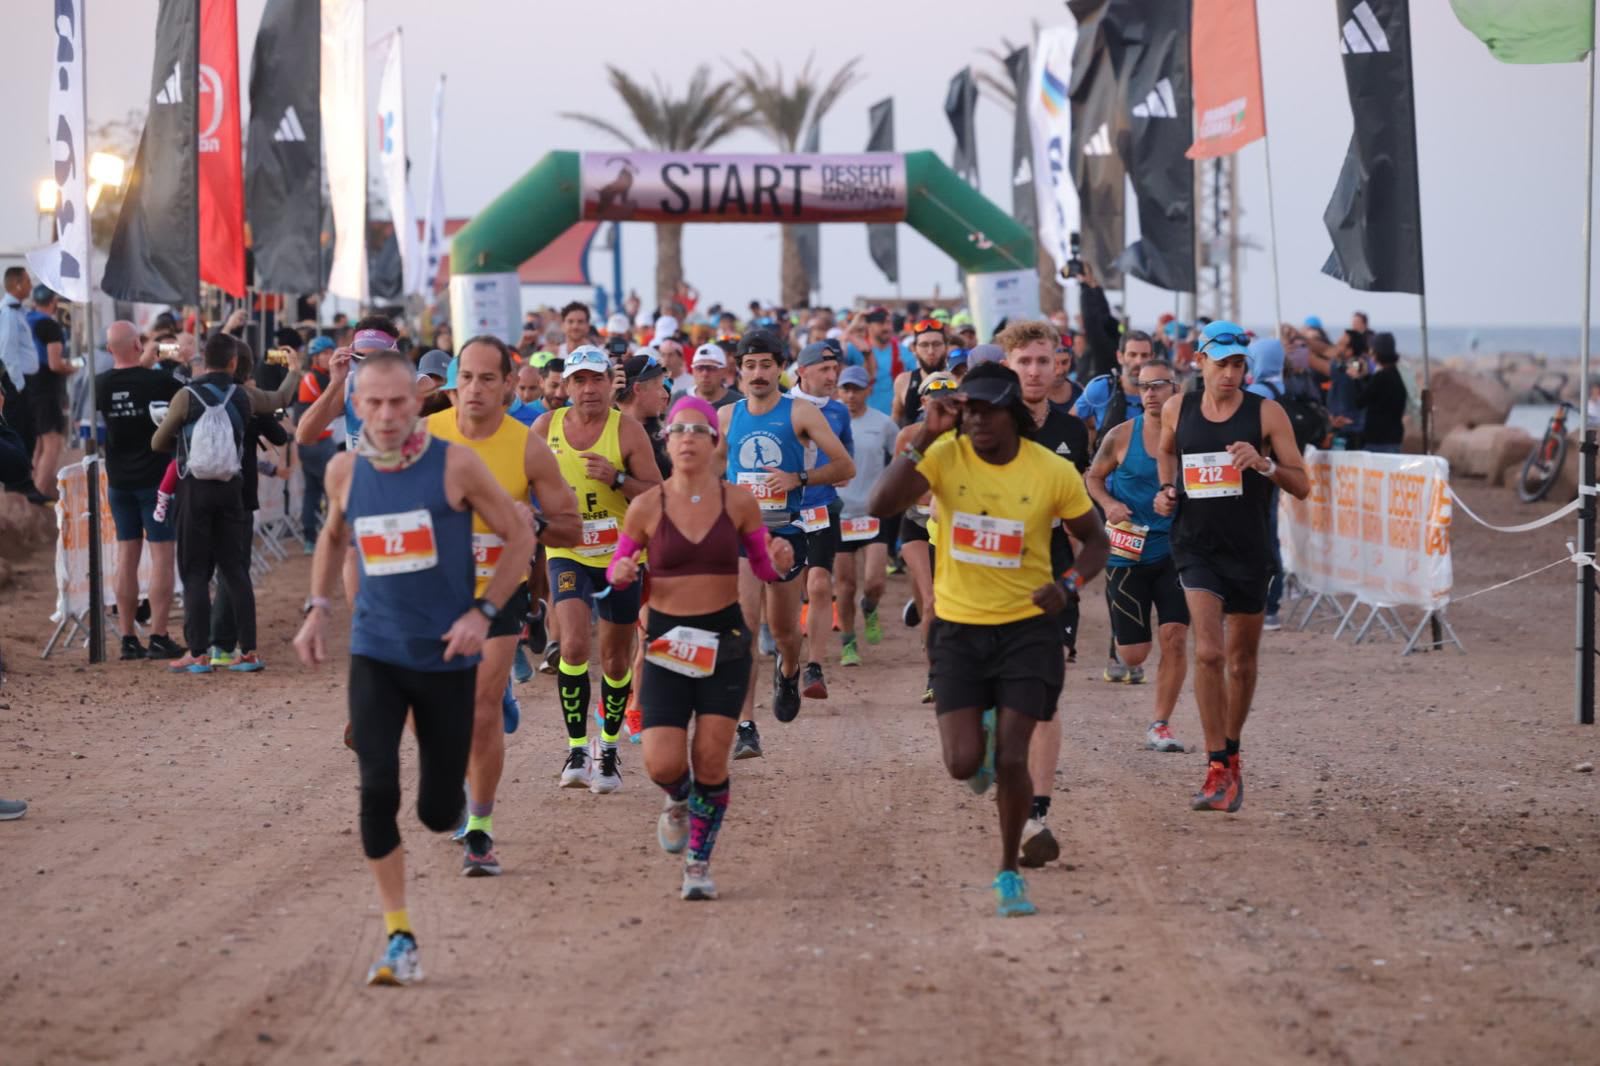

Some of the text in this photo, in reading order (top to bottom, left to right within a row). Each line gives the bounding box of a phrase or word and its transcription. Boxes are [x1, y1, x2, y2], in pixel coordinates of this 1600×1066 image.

[821, 164, 893, 184] DESERT
[660, 162, 812, 215] START
[1198, 465, 1223, 483] 212
[585, 492, 597, 512] F
[583, 532, 600, 545] 82
[972, 529, 1001, 551] 211
[1111, 531, 1132, 547] 1072
